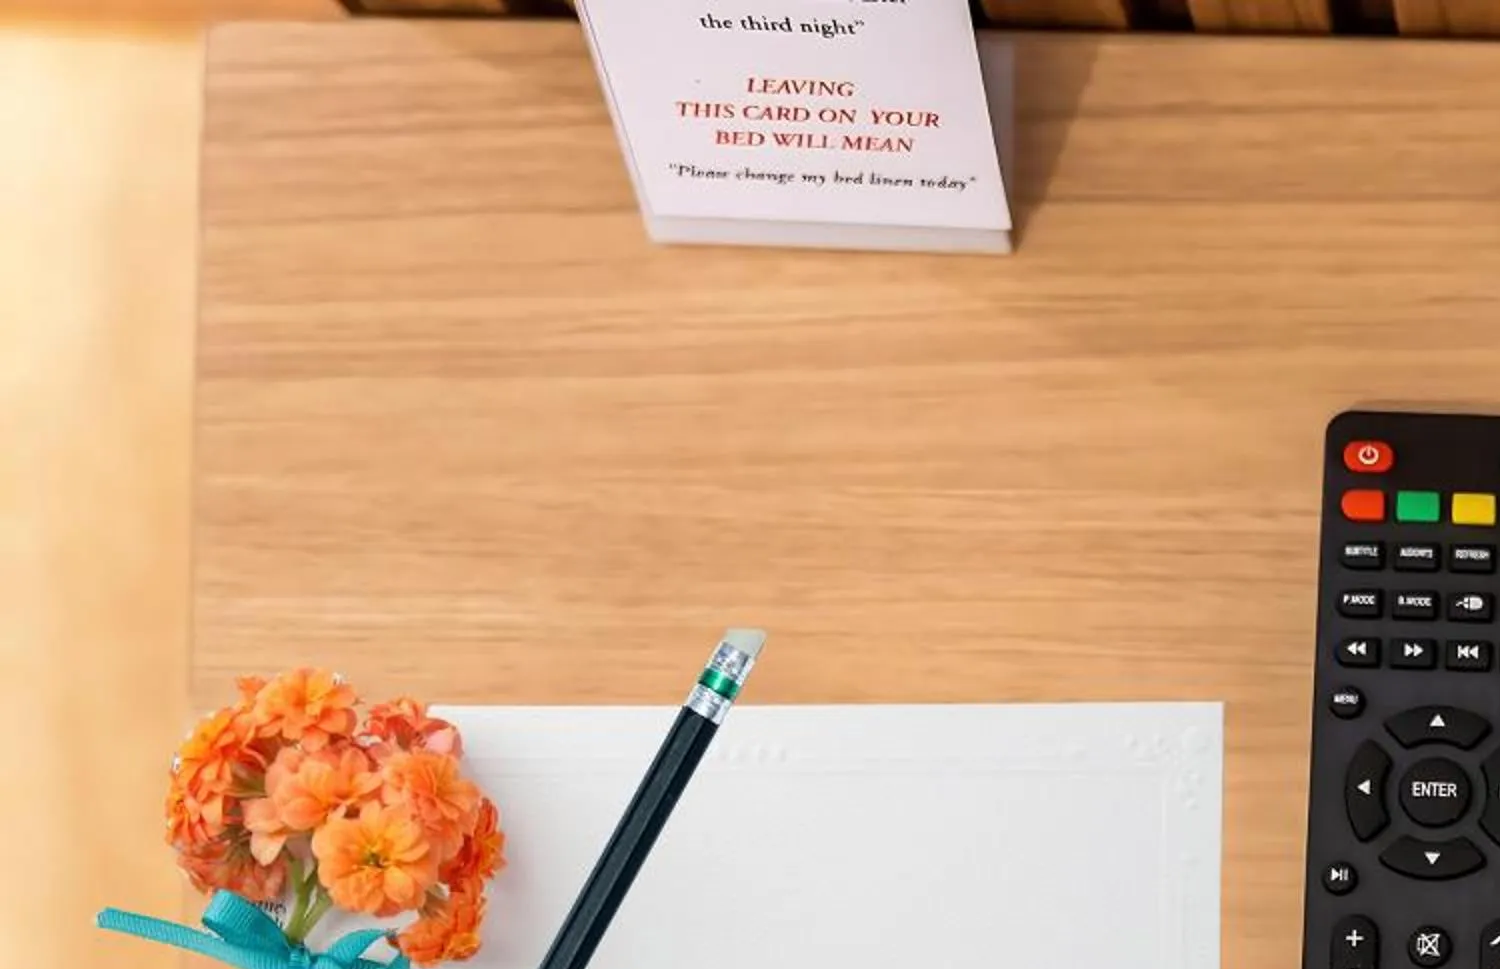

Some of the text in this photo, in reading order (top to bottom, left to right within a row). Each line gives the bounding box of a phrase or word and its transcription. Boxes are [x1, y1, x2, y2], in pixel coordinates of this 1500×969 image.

[699, 13, 733, 29] the
[740, 15, 793, 33] third
[747, 77, 855, 97] LEAVING
[677, 101, 940, 128] THIS CARD ON YOUR
[715, 129, 913, 153] BED WILL MEAN
[735, 167, 795, 185] change
[801, 172, 826, 187] my
[833, 170, 864, 185] bed
[869, 172, 914, 187] linen
[1333, 693, 1359, 705] MENU
[1412, 781, 1457, 798] ENTER
